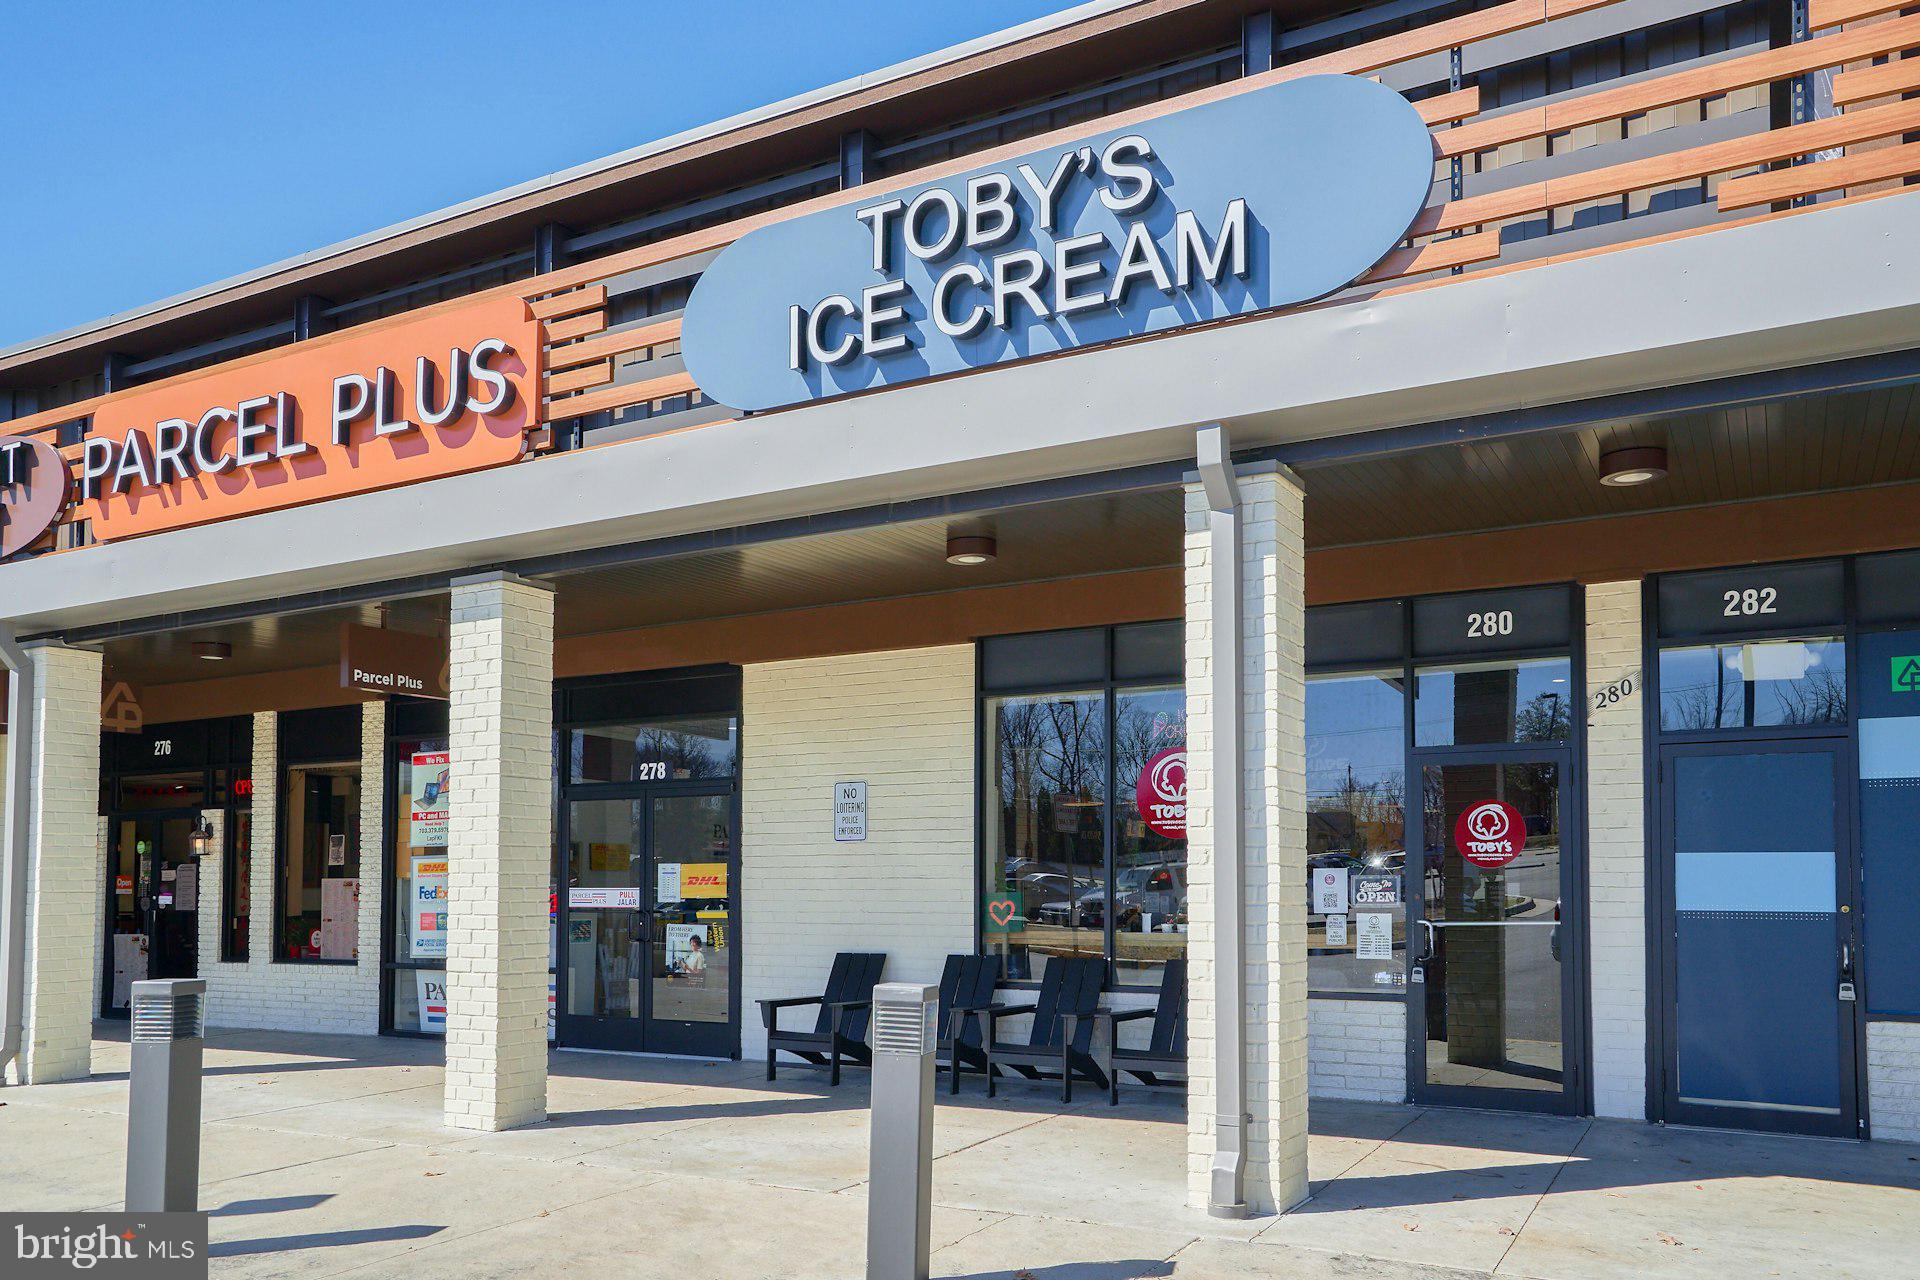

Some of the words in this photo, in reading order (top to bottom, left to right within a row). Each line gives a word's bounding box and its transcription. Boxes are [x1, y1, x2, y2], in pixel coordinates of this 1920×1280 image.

[856, 134, 1157, 274] TOBY'S
[789, 280, 910, 372] ICE
[932, 198, 1249, 340] CREAM
[83, 391, 316, 499] PARCEL
[332, 338, 516, 441] PLUS
[1723, 587, 1777, 616] 282
[1467, 610, 1513, 637] 280
[353, 669, 394, 686] Parcel
[397, 674, 423, 690] Plus
[1595, 678, 1632, 709] 280
[154, 740, 171, 755] 276
[639, 762, 666, 780] 278
[235, 779, 253, 796] OPE
[843, 788, 857, 799] NO
[837, 802, 864, 814] LOITERING
[1150, 804, 1186, 818] TOB
[418, 812, 426, 820] PC
[439, 811, 449, 819] MA
[842, 816, 858, 824] POLICE
[838, 826, 862, 835] ENFORCED
[1466, 839, 1513, 852] TOBY'S
[117, 878, 131, 888] Open
[687, 876, 720, 886] DHL
[1360, 880, 1381, 889] Come
[1356, 891, 1396, 902] OPEN
[712, 922, 720, 953] Western
